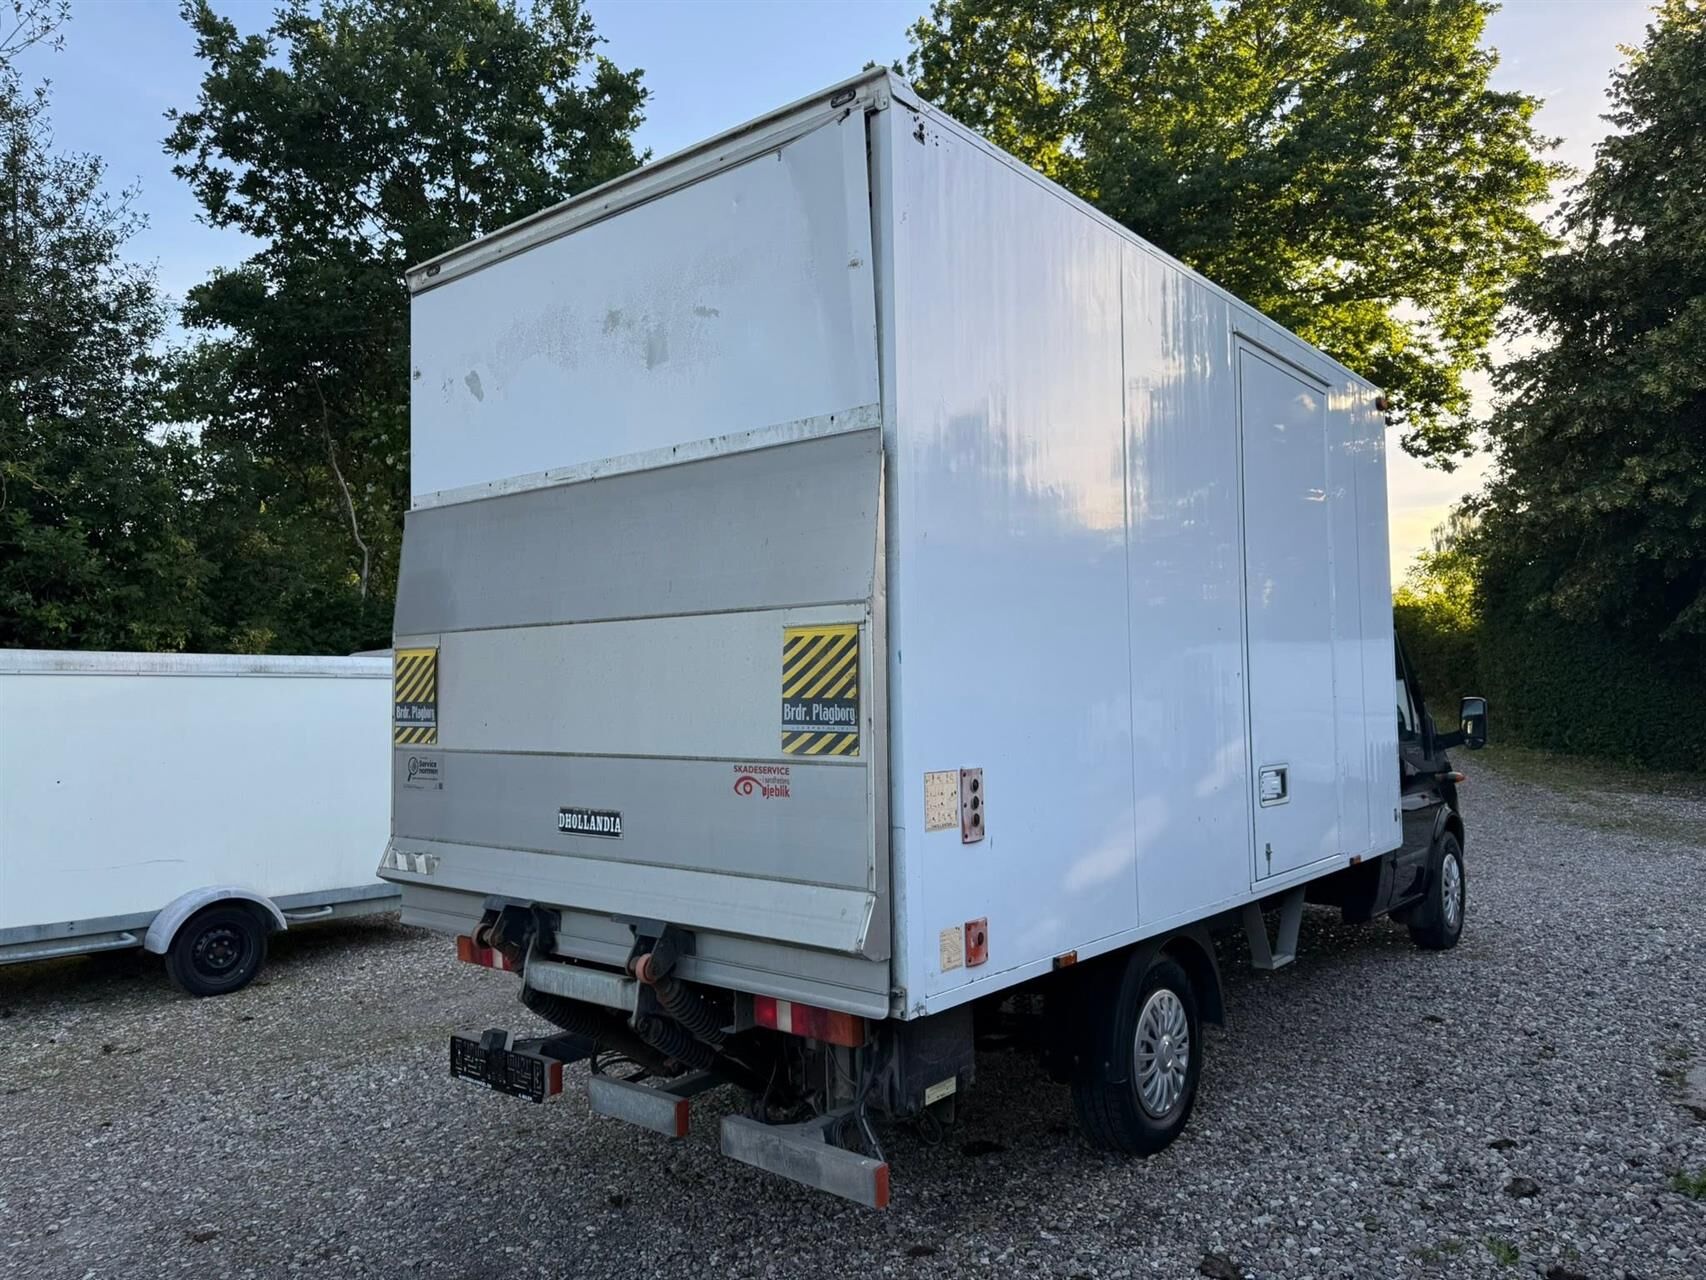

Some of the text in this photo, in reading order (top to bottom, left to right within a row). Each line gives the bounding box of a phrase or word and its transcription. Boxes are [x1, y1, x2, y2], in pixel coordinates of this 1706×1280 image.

[396, 704, 411, 719] Brdr.
[783, 703, 856, 724] Brdr. Plagborg
[733, 764, 790, 775] SKADESERVICE
[558, 812, 622, 833] DHOLLANDIA
